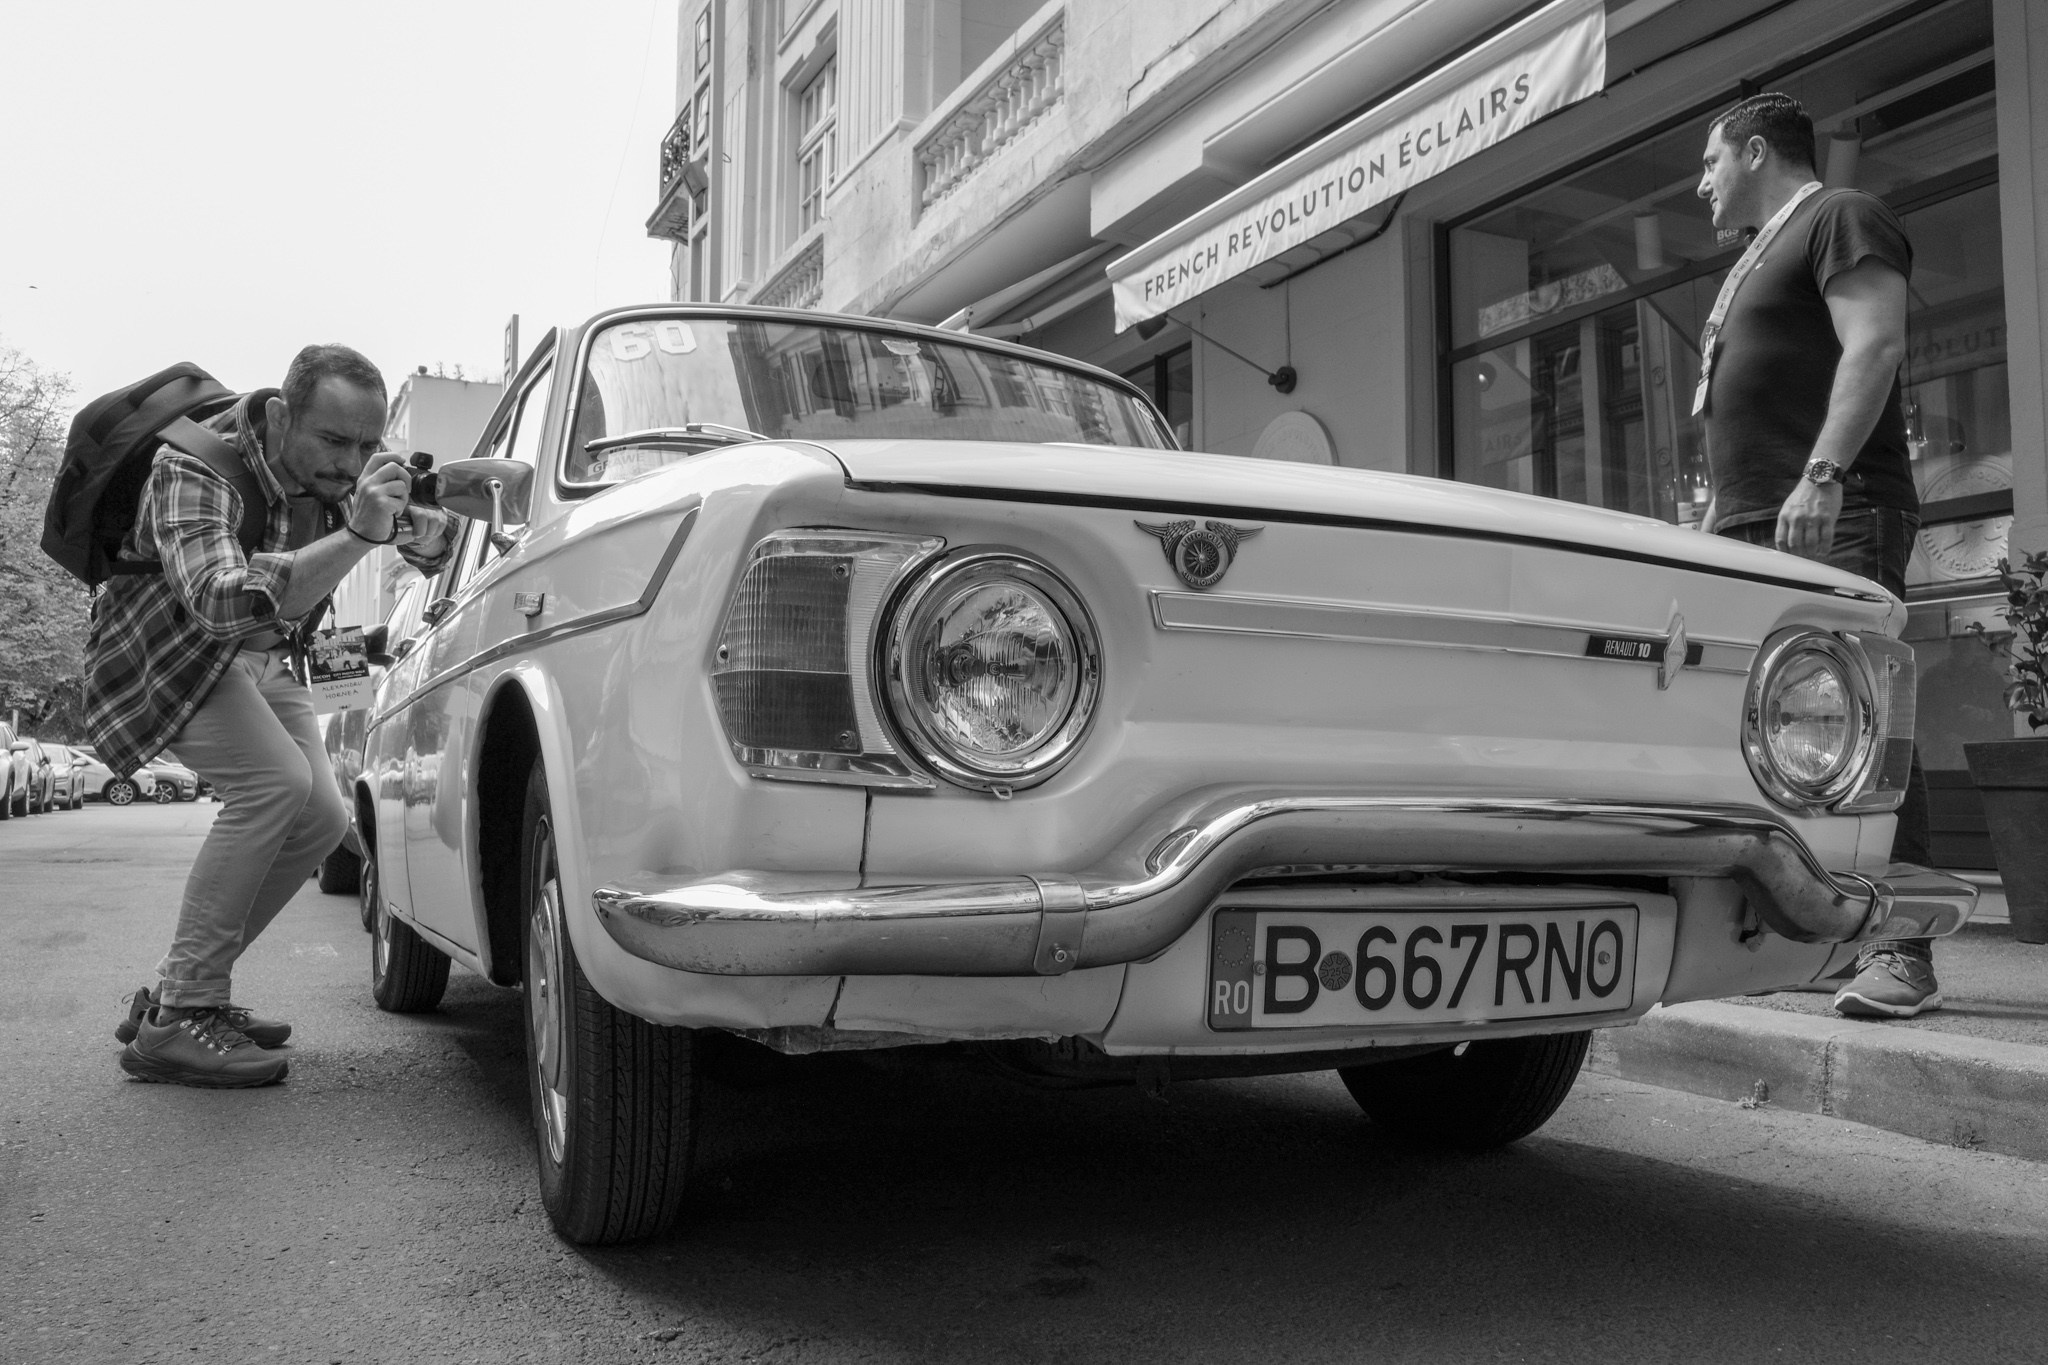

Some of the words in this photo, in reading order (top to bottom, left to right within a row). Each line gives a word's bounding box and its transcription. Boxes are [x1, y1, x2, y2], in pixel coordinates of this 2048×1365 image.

[1145, 243, 1218, 302] FRENCH
[1228, 153, 1385, 257] REVOLUTION
[1399, 73, 1530, 168] ÉCLAIRS
[1759, 228, 1772, 243] THETA
[1737, 258, 1749, 273] THETA
[609, 320, 697, 361] 60
[1604, 639, 1637, 657] RENAULT
[1638, 643, 1651, 658] 10
[322, 681, 363, 692] ALEXANDRU
[325, 689, 360, 700] HORNEA
[1264, 925, 1322, 1014] B
[1329, 967, 1341, 977] 25
[1214, 980, 1250, 1015] RO
